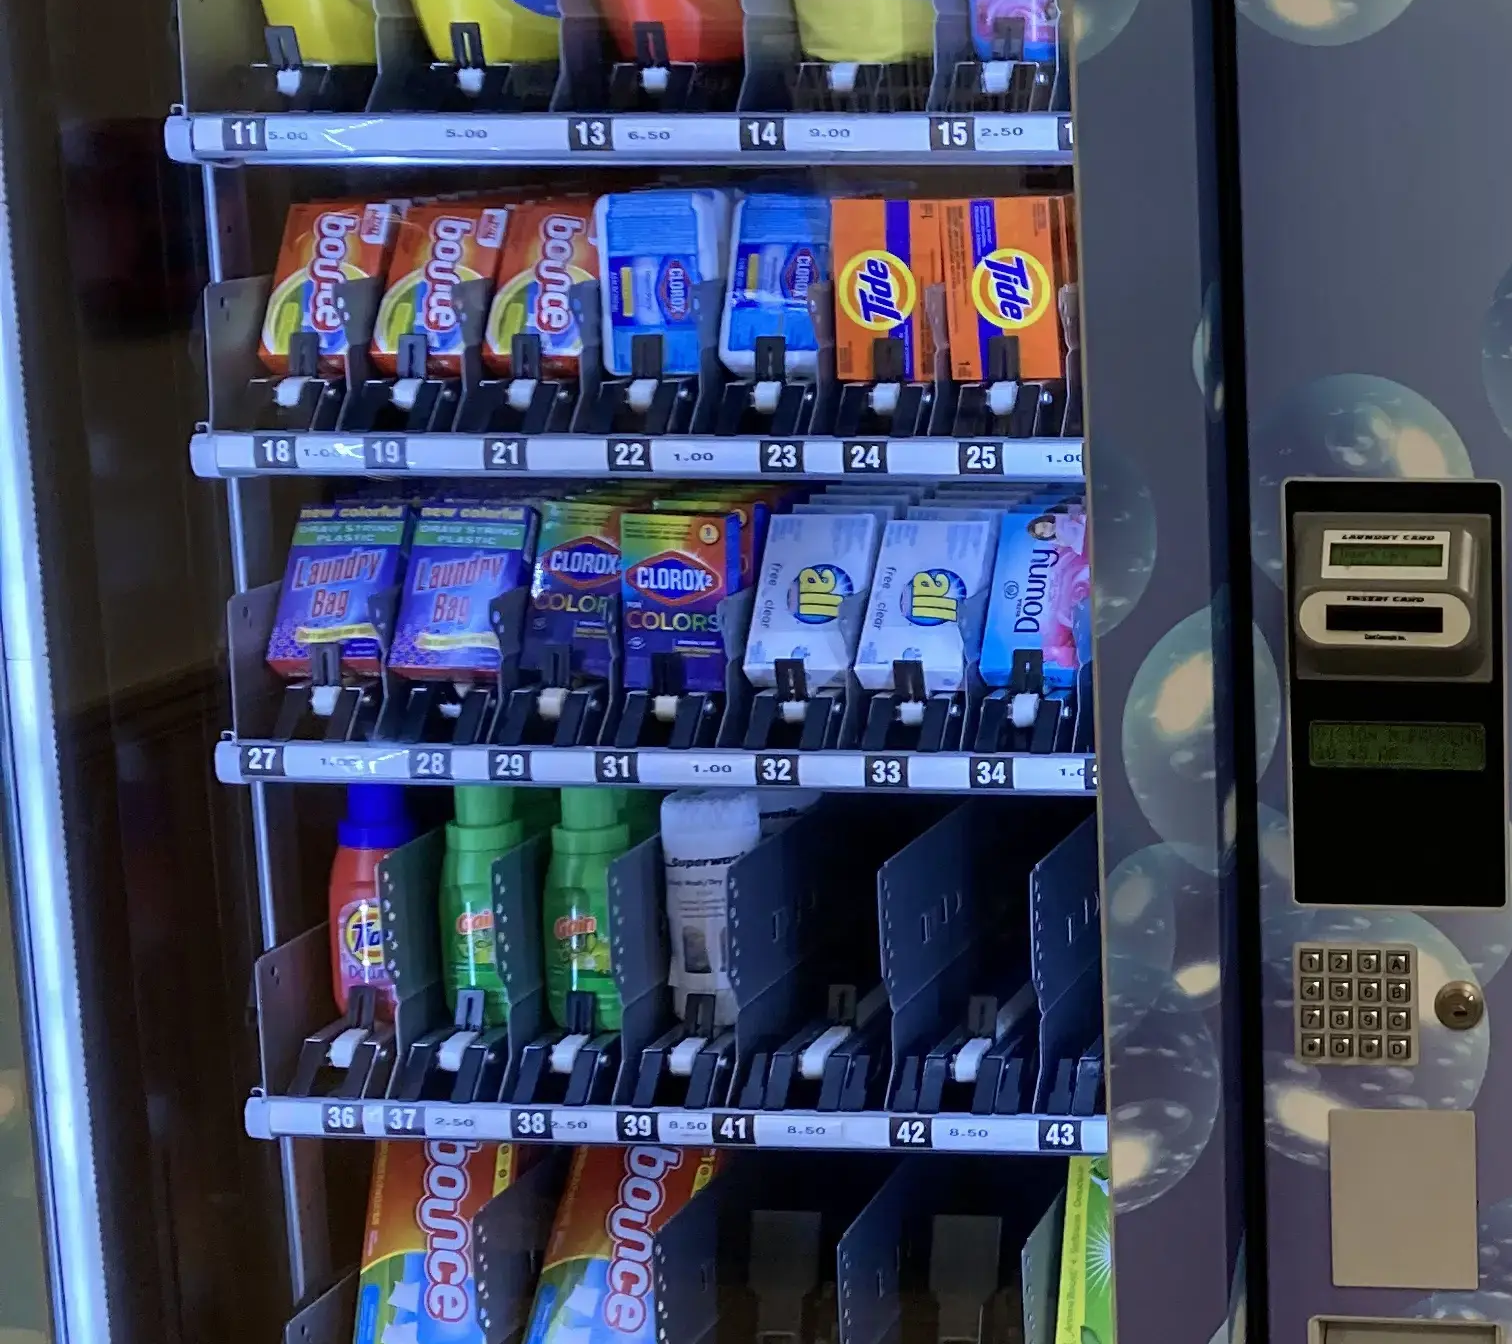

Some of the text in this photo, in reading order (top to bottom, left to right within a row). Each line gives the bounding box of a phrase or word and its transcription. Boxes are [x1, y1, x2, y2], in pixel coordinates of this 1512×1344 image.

[231, 121, 258, 145] 11
[445, 128, 488, 140] 5.00
[575, 121, 606, 146] 13
[628, 130, 671, 141] 6.50
[748, 122, 777, 145] 14
[938, 121, 968, 146] 15
[981, 126, 1024, 137] 2.50
[859, 258, 904, 323] Tide
[984, 255, 1033, 321] Tide
[263, 440, 289, 462] 18
[372, 441, 399, 463] 19
[492, 442, 518, 464] 21
[614, 443, 644, 466] 22
[673, 453, 713, 461] 1.00
[768, 444, 797, 467] 23
[851, 446, 880, 468] 24
[967, 446, 996, 468] 25
[294, 548, 384, 590] Laundry
[415, 551, 507, 593] Laundry
[1013, 548, 1061, 634] Downy
[312, 588, 350, 619] Bag
[432, 592, 471, 625] Bag
[626, 609, 721, 633] COLORS
[248, 748, 276, 770] 27
[417, 752, 444, 774] 28
[496, 753, 524, 775] 29
[603, 755, 630, 777] 31
[693, 764, 732, 773] 1.00
[762, 759, 791, 781] 32
[872, 760, 901, 783] 33
[977, 761, 1006, 784] 34
[1308, 958, 1401, 970] 1 2 3 A
[1306, 986, 1314, 996] 4
[1335, 986, 1343, 997] 5
[1364, 987, 1372, 998] 6
[1307, 1014, 1401, 1026] 7 8 9 C
[1392, 1044, 1402, 1054] D
[328, 1107, 355, 1128] 36
[389, 1108, 416, 1129] 37
[435, 1117, 474, 1127] 2.50
[517, 1112, 545, 1134] 38
[624, 1114, 651, 1136] 39
[669, 1120, 707, 1130] 8.50
[720, 1116, 746, 1138] 41
[787, 1125, 826, 1135] 8.50
[896, 1121, 925, 1143] 42
[949, 1128, 988, 1138] 8.50
[1046, 1123, 1075, 1146] 43
[416, 1140, 482, 1323] bounce
[605, 1145, 684, 1334] bounce
